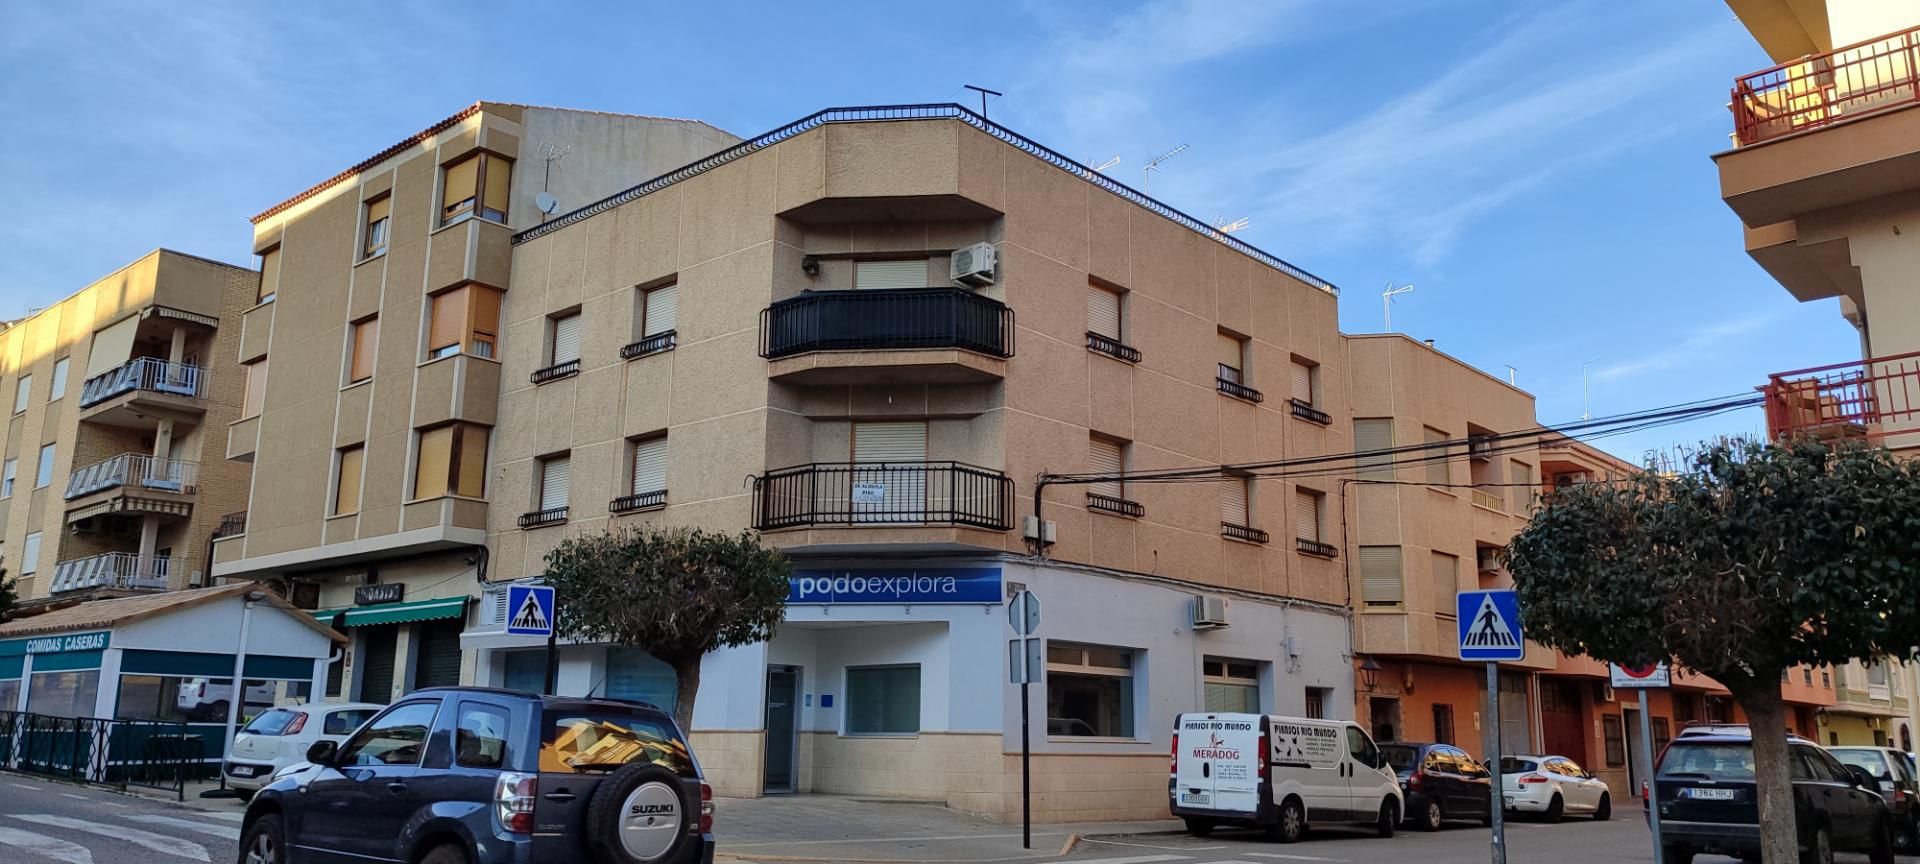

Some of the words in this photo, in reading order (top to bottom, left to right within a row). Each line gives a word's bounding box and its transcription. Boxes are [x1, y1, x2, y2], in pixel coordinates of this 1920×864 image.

[799, 571, 957, 599] podoexplora
[26, 638, 62, 654] COMIDAS
[64, 633, 105, 651] CASERAS
[1185, 722, 1209, 731] PIENSOS
[1224, 723, 1252, 731] MUNDO
[1274, 724, 1300, 735] PIENSOS
[1300, 726, 1313, 736] RIO
[1313, 727, 1337, 738] MUNDO
[1192, 749, 1240, 760] MERADOG
[631, 804, 674, 814] SUZUKI
